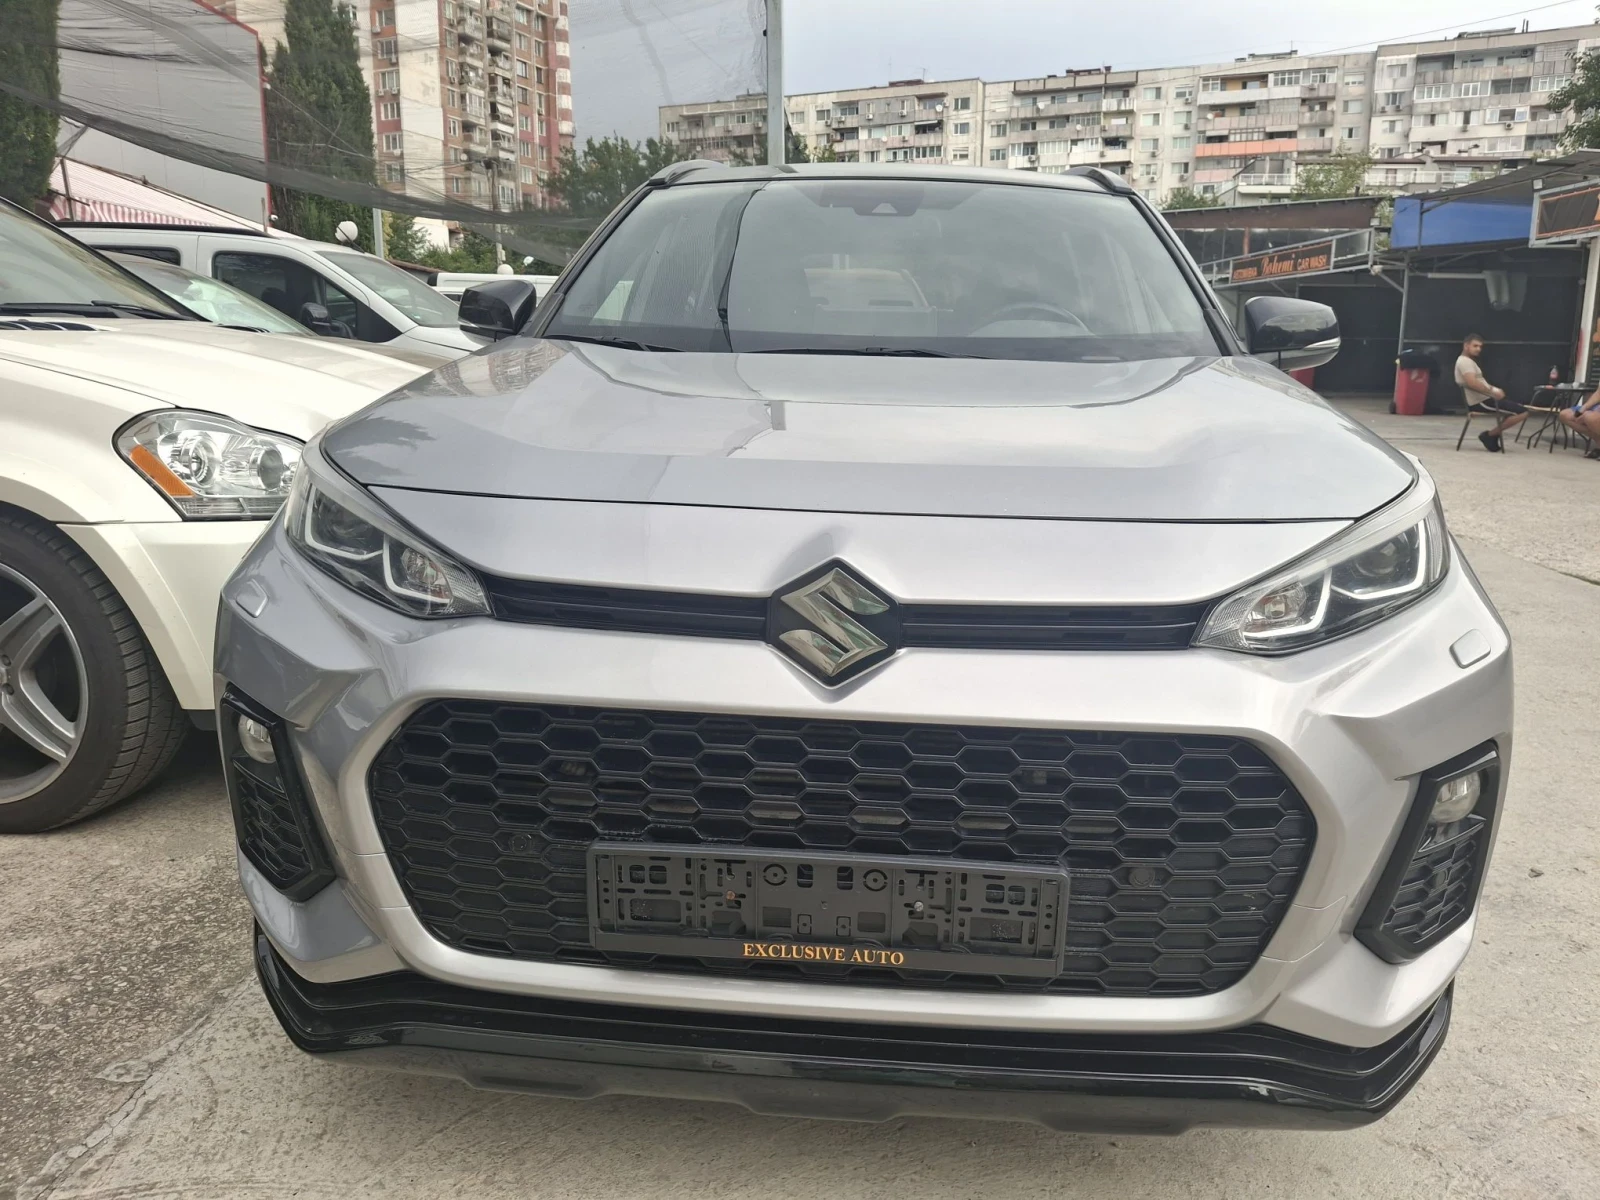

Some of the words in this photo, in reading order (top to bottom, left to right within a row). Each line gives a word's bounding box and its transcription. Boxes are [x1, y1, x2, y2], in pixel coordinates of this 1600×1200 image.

[1297, 258, 1310, 271] CAR
[1310, 254, 1327, 269] WASH
[743, 943, 846, 961] EXCLUSIVE
[850, 949, 904, 965] AUTO
